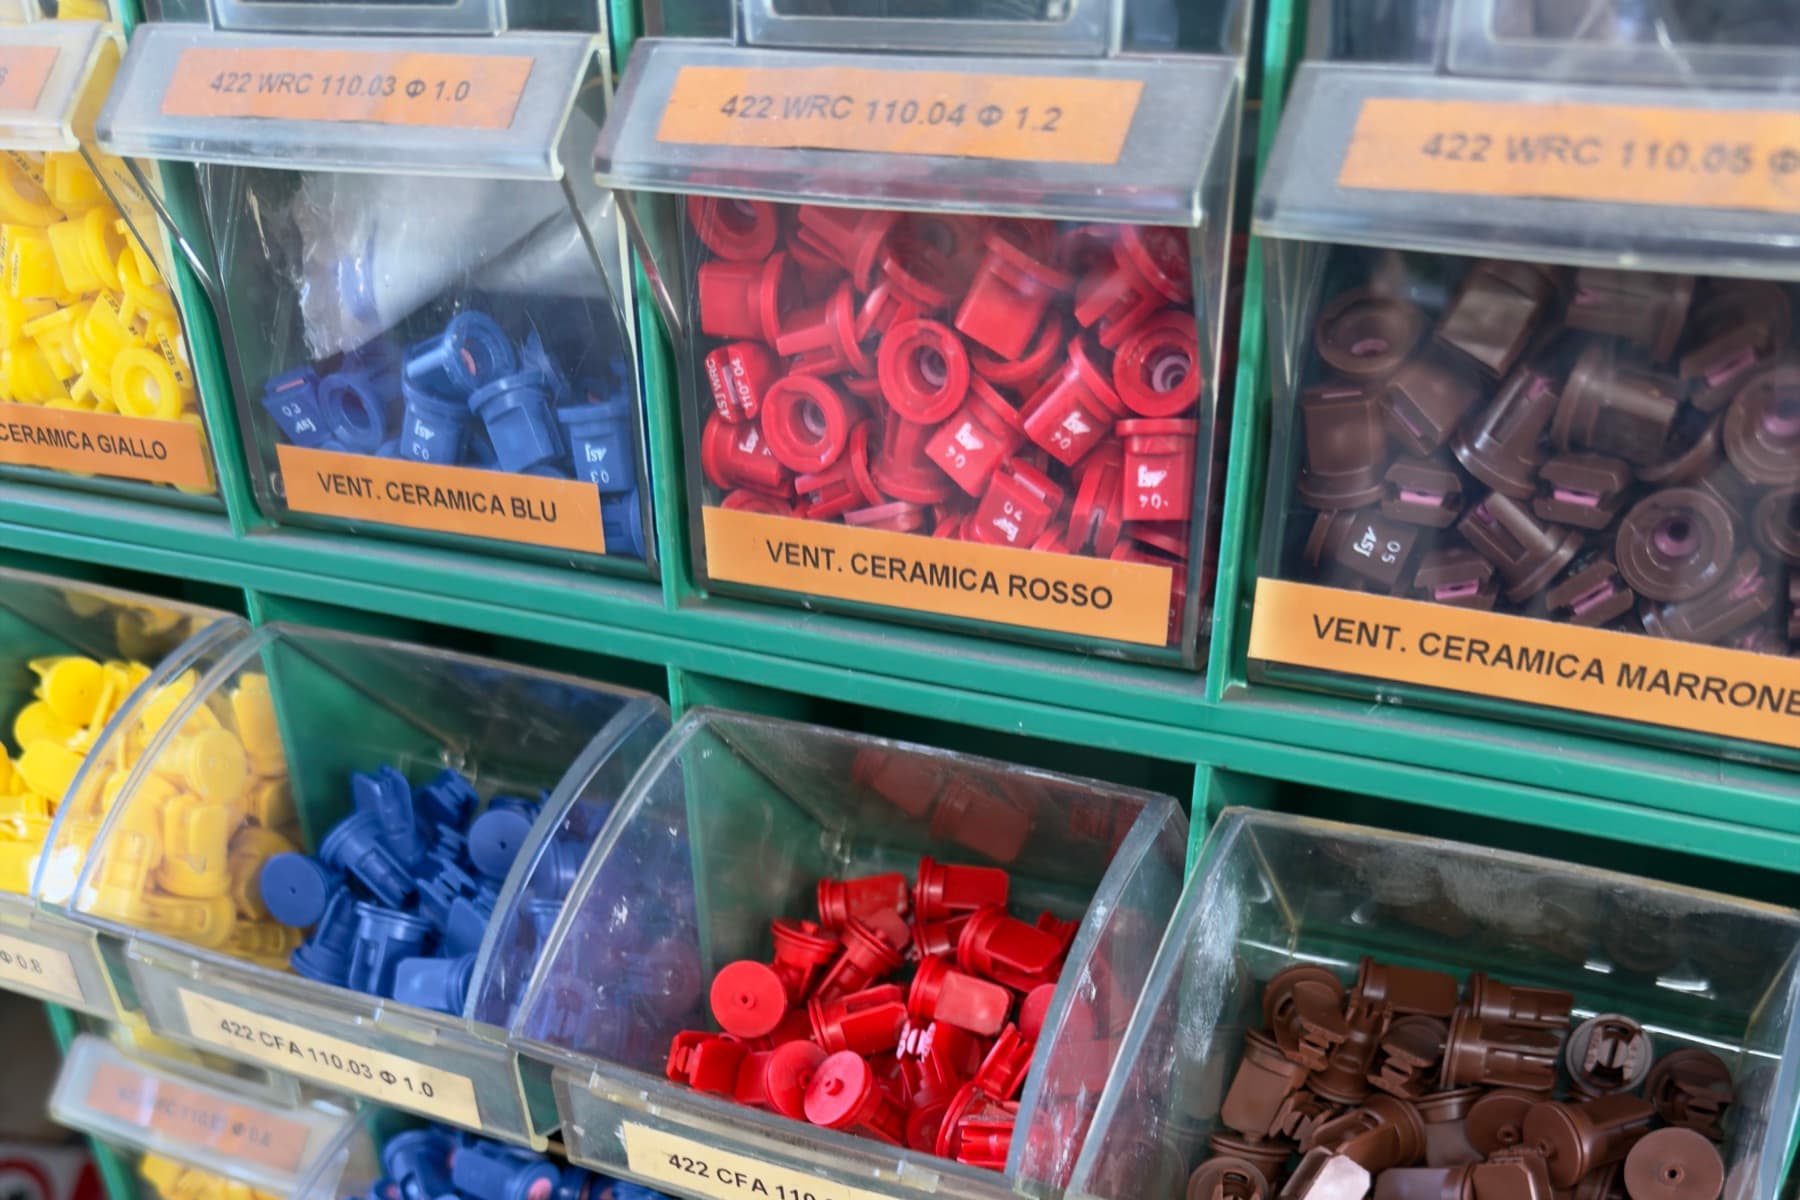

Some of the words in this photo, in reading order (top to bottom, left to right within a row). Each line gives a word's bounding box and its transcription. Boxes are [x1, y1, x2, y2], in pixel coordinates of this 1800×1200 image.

[210, 72, 251, 94] 422
[257, 73, 313, 95] WRC
[321, 75, 397, 97] 110.03
[434, 80, 471, 101] 1.0
[720, 95, 773, 120] 422
[783, 95, 855, 120] WRC
[866, 99, 966, 128] 110.04
[1015, 105, 1063, 132] 1.2
[1420, 132, 1492, 163] 422
[1505, 133, 1602, 166] WRC
[1620, 138, 1755, 175] 110.05
[0, 422, 95, 452] CERAMICA
[97, 434, 168, 461] GIALLO
[317, 471, 382, 501] VENT.
[385, 481, 506, 516] CERAMICA
[511, 497, 558, 523] BLU
[765, 538, 844, 574] VENT.
[850, 551, 1001, 597] CERAMICA
[1007, 573, 1114, 611] ROSSO
[1312, 613, 1407, 653] VENT.
[1417, 631, 1605, 685] CERAMICA
[1615, 662, 1800, 718] MARRONE
[219, 1018, 255, 1042] 422
[259, 1030, 304, 1058] CFA
[307, 1046, 374, 1081] 110.03
[403, 1076, 435, 1099] 1.0
[669, 1153, 711, 1178] 422
[716, 1167, 769, 1196] CFA
